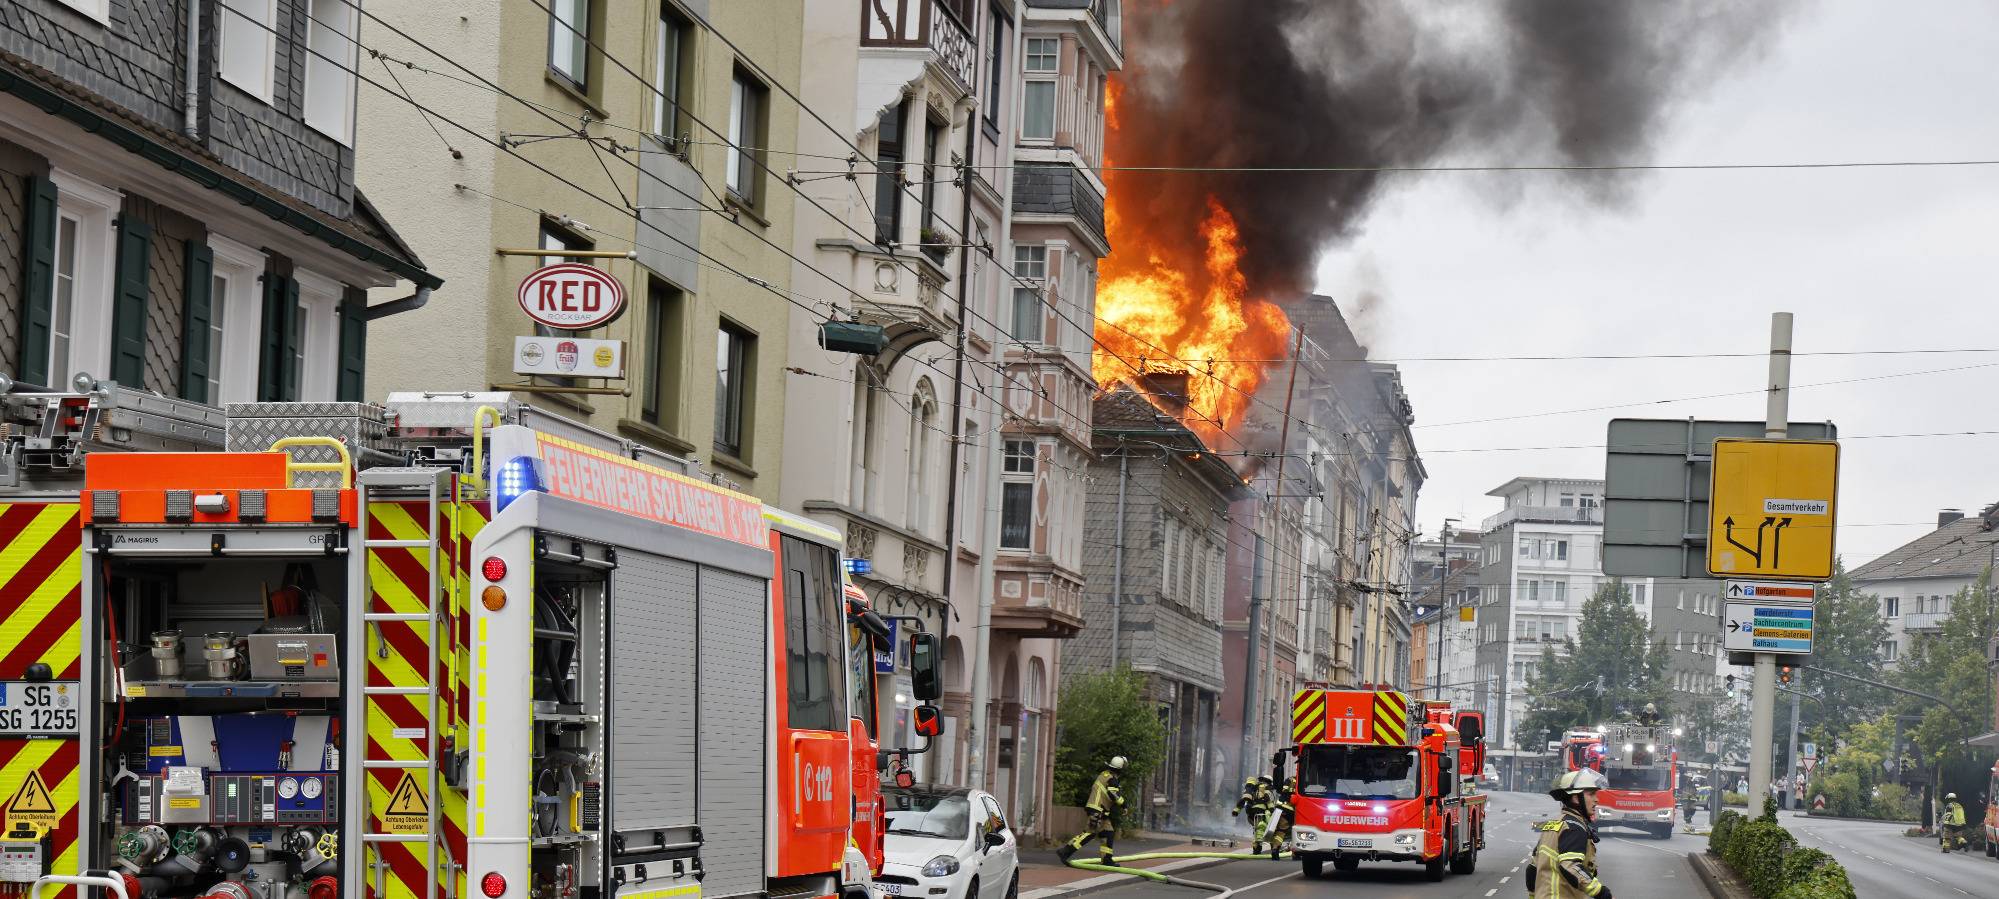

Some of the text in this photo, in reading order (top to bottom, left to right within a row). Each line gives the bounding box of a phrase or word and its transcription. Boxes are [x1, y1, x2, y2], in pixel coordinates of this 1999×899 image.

[539, 281, 600, 311] RED
[544, 444, 763, 545] FEUERWEHR SOLINGEN 112
[1767, 501, 1825, 512] Gesamtverkehr
[1755, 587, 1786, 596] Hofgarten
[24, 686, 51, 706] SG
[0, 709, 76, 729] SG 1255
[1332, 717, 1366, 739] III
[816, 766, 832, 801] 112
[1323, 815, 1389, 825] FEUERWEHR
